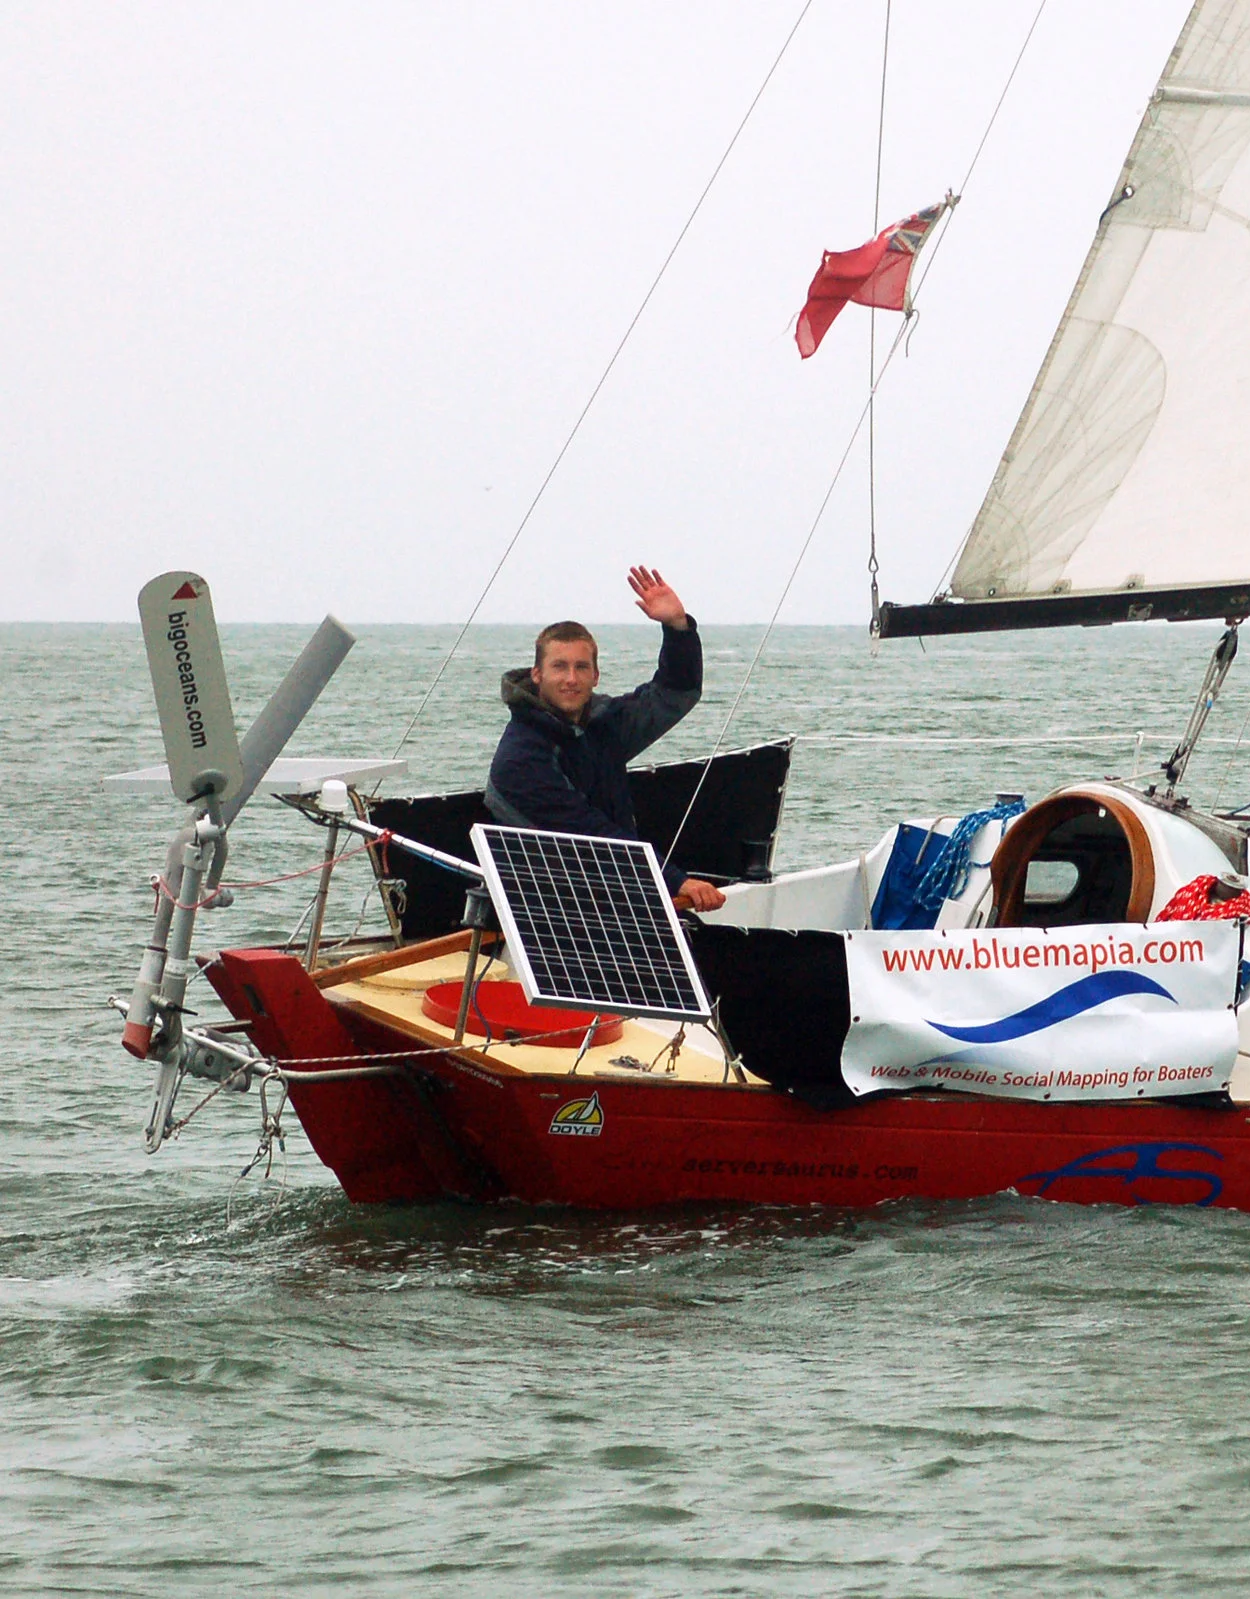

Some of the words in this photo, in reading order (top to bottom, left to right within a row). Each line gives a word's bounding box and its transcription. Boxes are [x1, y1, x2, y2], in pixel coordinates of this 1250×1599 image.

[167, 610, 208, 749] bigoceans.com
[882, 935, 1204, 973] www.bluemapia.com
[870, 1065, 911, 1078] Web
[914, 1066, 929, 1078] &
[931, 1066, 998, 1086] Mobile
[1000, 1070, 1055, 1087] Social
[1056, 1068, 1129, 1090] Mapping
[1132, 1066, 1155, 1083] for
[1157, 1064, 1214, 1082] Boaters
[550, 1124, 601, 1135] DOYLE
[682, 1156, 920, 1181] serversaurus.com
